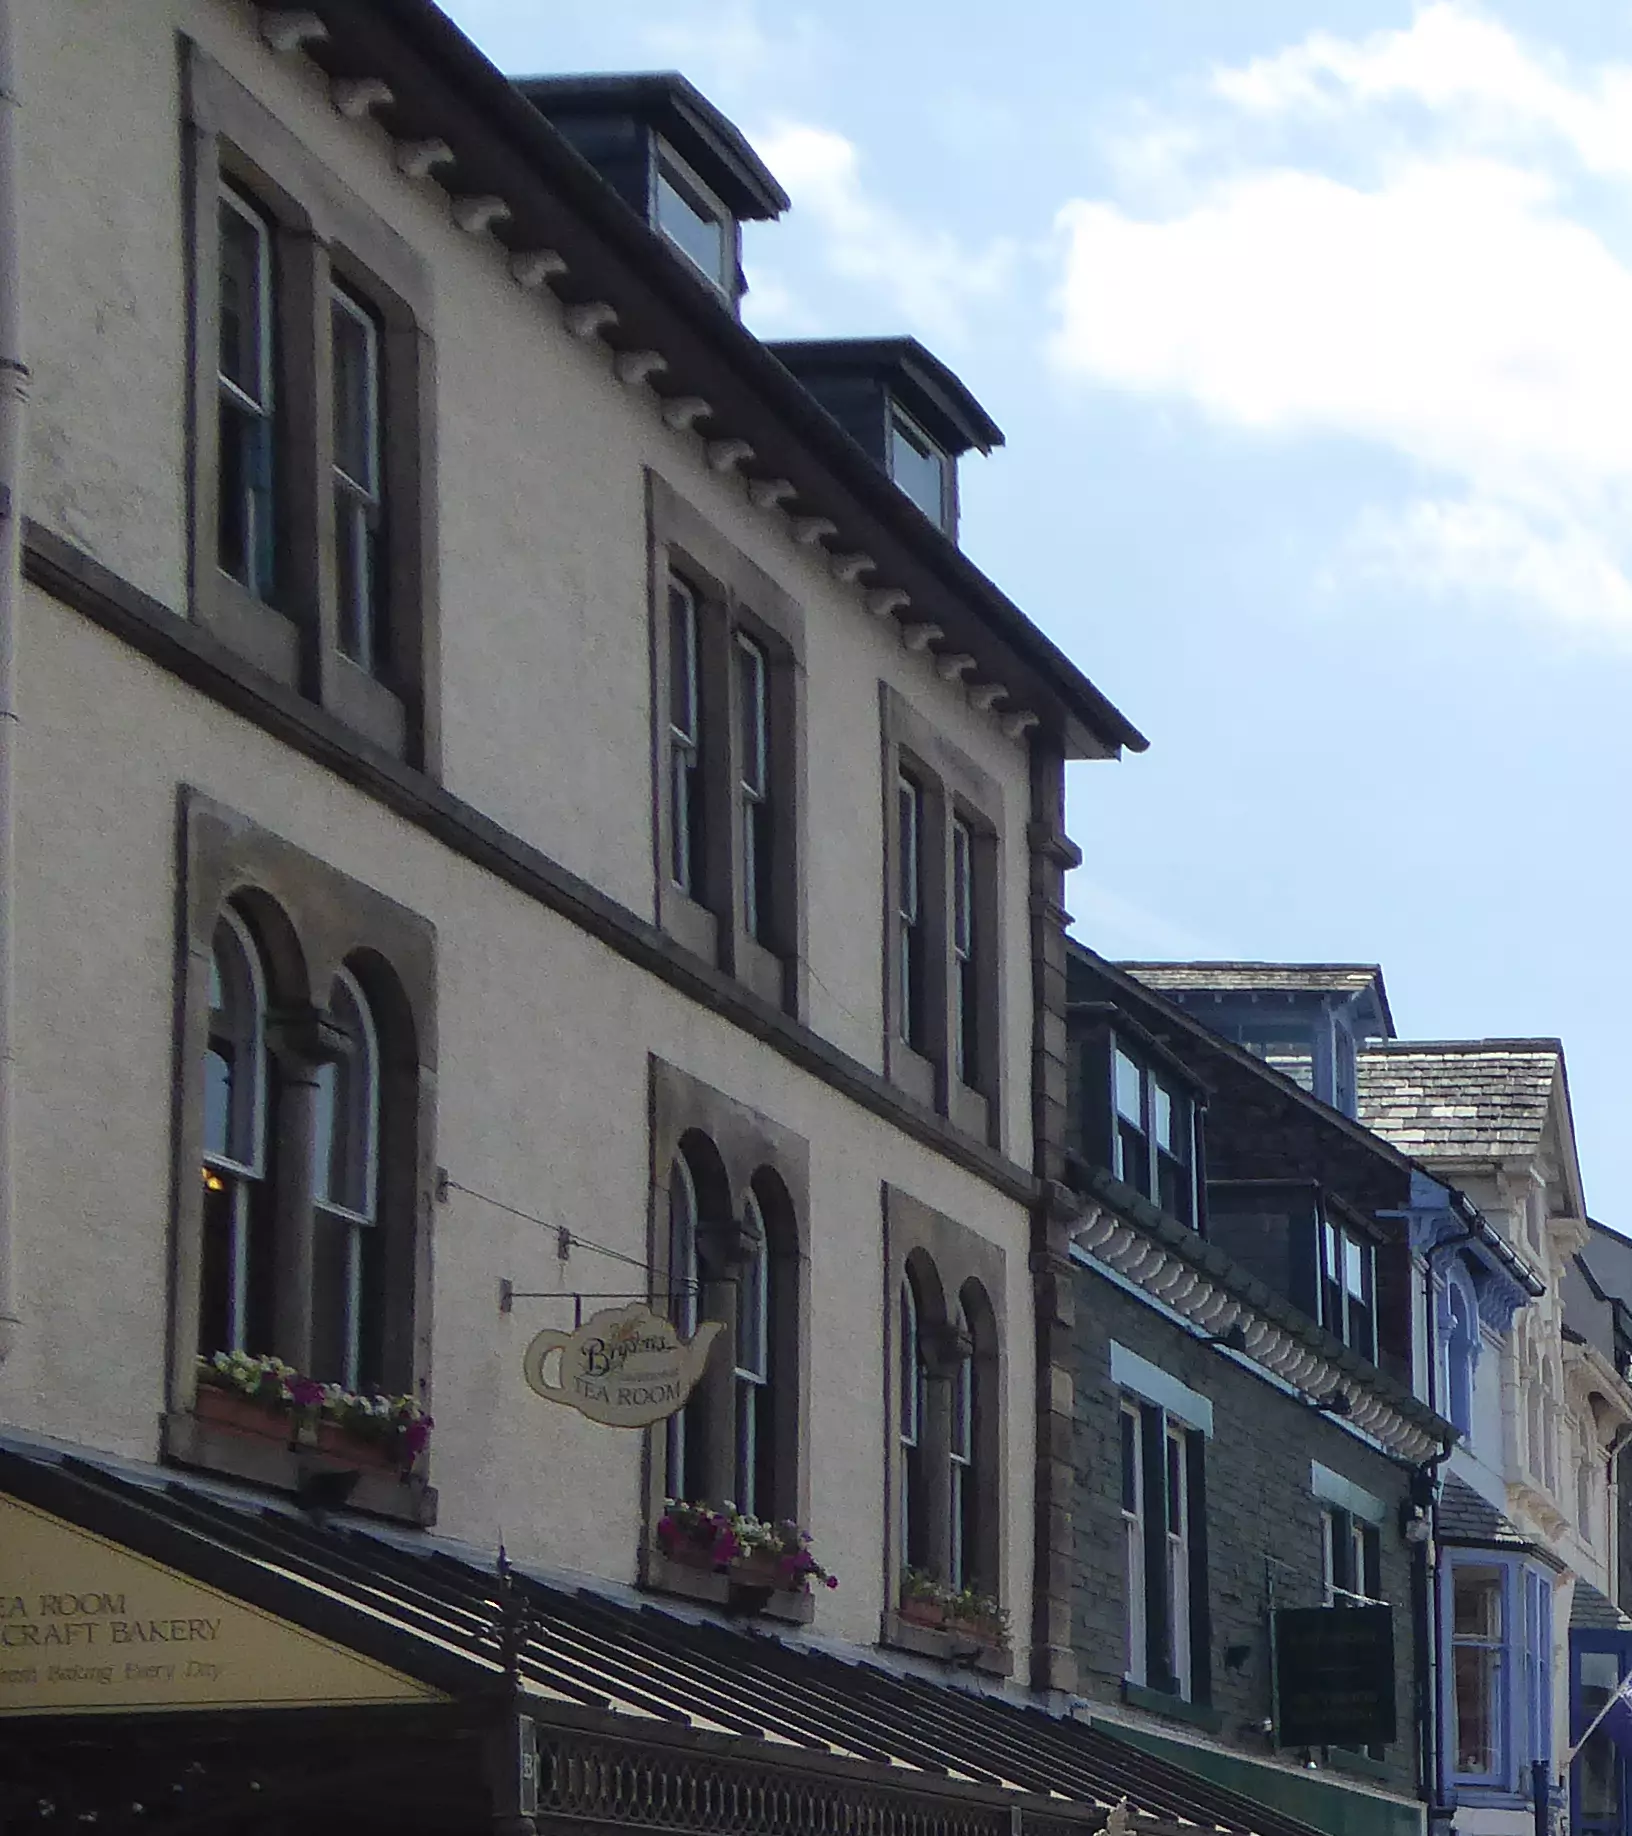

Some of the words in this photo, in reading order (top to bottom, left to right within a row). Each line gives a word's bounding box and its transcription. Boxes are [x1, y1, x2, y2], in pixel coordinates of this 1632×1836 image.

[573, 1376, 609, 1403] TEA
[618, 1380, 680, 1406] ROOM
[40, 1593, 125, 1616] ROOM
[1, 1622, 99, 1646] CRAFT
[110, 1618, 221, 1643] BAKERY
